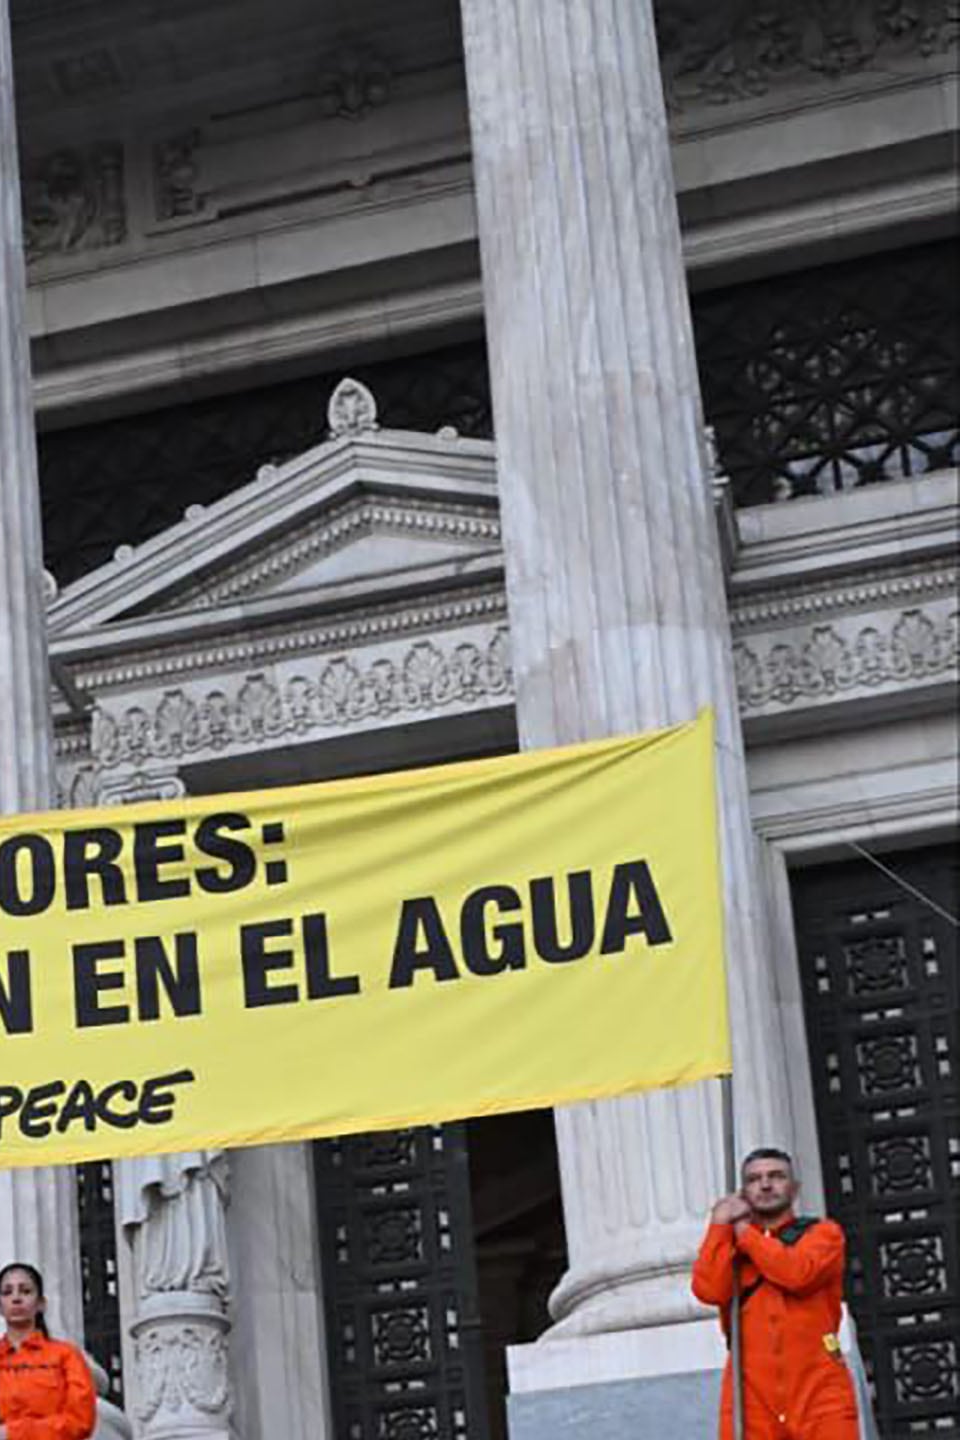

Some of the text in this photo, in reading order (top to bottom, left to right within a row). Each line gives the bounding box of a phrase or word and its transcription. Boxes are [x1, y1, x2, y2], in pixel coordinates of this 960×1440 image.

[71, 931, 202, 1029] EN
[240, 912, 361, 1009] EL
[388, 859, 673, 989] AGUA
